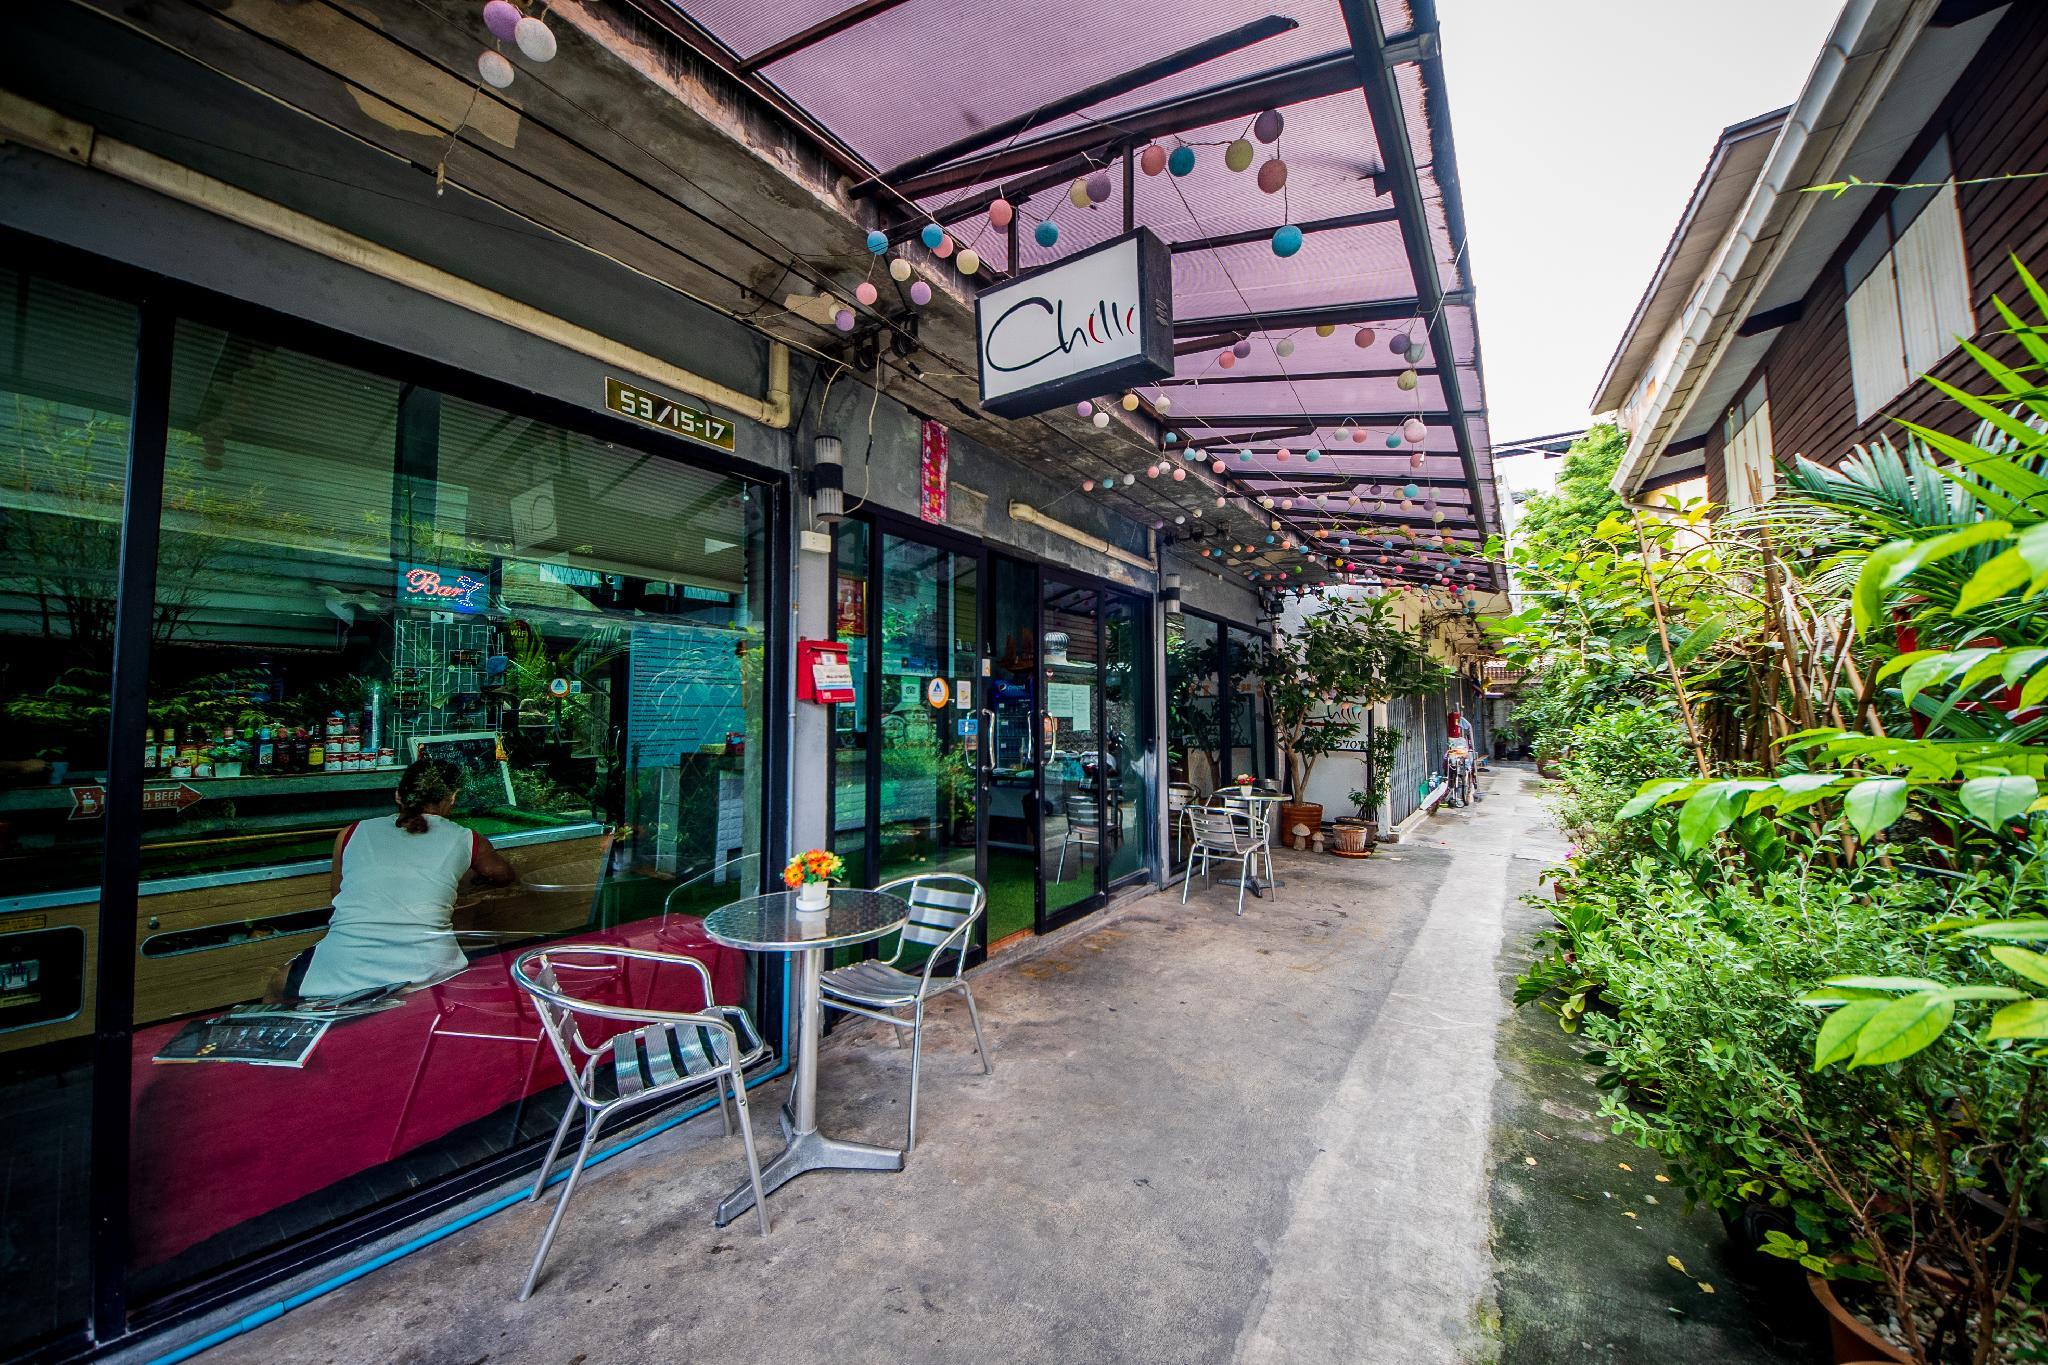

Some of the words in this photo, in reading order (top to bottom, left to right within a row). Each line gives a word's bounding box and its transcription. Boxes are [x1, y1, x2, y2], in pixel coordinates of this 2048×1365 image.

[985, 296, 1136, 372] Chilli
[620, 389, 725, 440] 53/15-17
[405, 568, 466, 597] Bar
[154, 790, 182, 802] BEER
